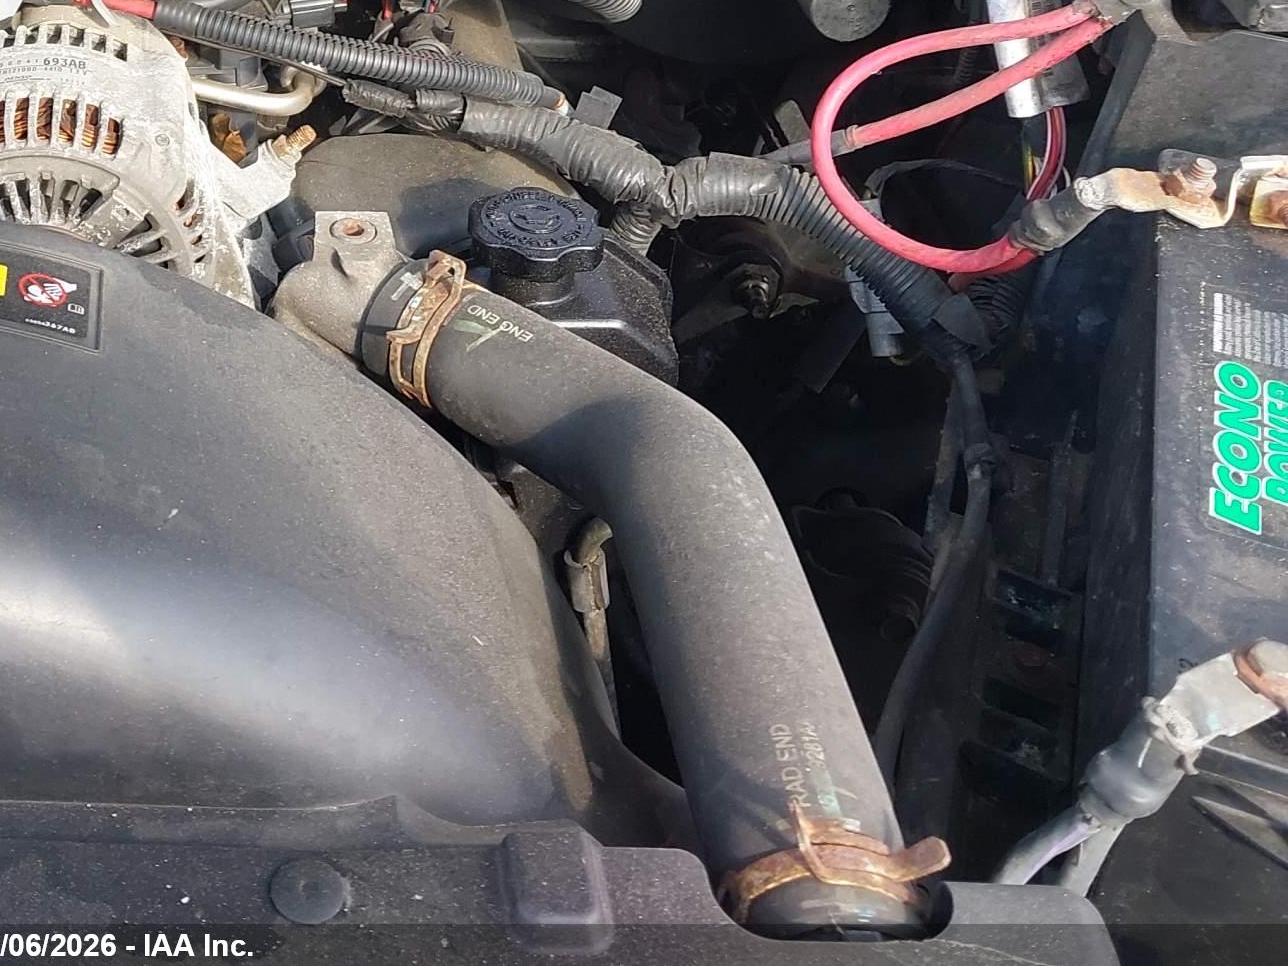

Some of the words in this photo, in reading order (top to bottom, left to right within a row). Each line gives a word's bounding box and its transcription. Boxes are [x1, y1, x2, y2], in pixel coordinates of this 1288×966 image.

[466, 304, 501, 325] END
[500, 320, 534, 343] ENG
[1208, 360, 1262, 534] ECONO
[769, 723, 799, 762] END
[781, 766, 812, 810] RAD
